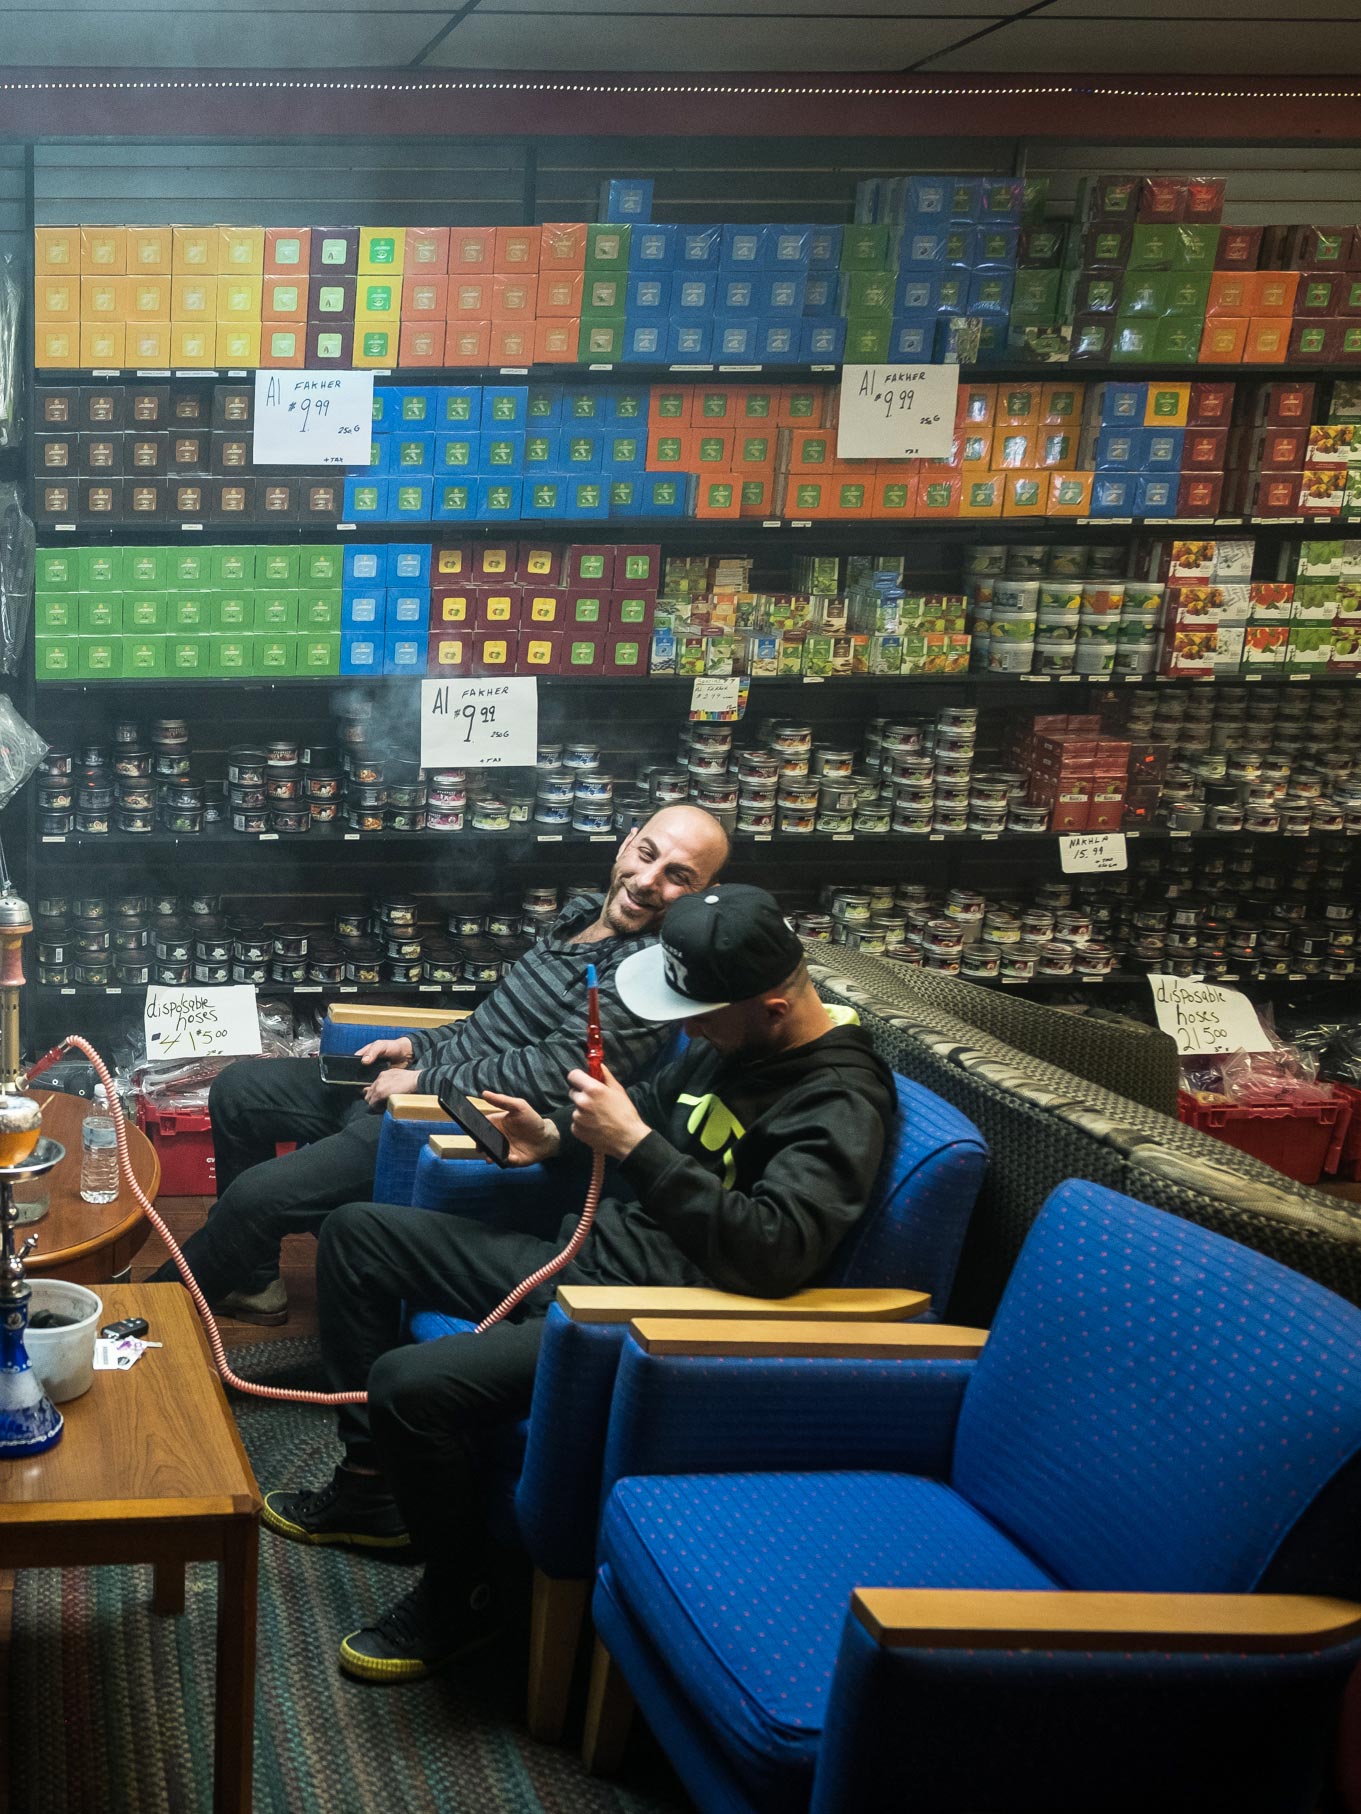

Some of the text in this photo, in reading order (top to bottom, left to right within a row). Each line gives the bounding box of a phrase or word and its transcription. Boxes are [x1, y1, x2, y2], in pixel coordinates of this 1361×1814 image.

[294, 379, 341, 391] FAKHER
[884, 371, 927, 383] FAKHER
[462, 686, 509, 698] FAKHER
[1069, 836, 1109, 849] NAKHLA
[1157, 979, 1226, 1004] disposable
[147, 993, 216, 1018] disposable
[1176, 1003, 1220, 1026] hoses
[176, 1009, 218, 1032] hoses
